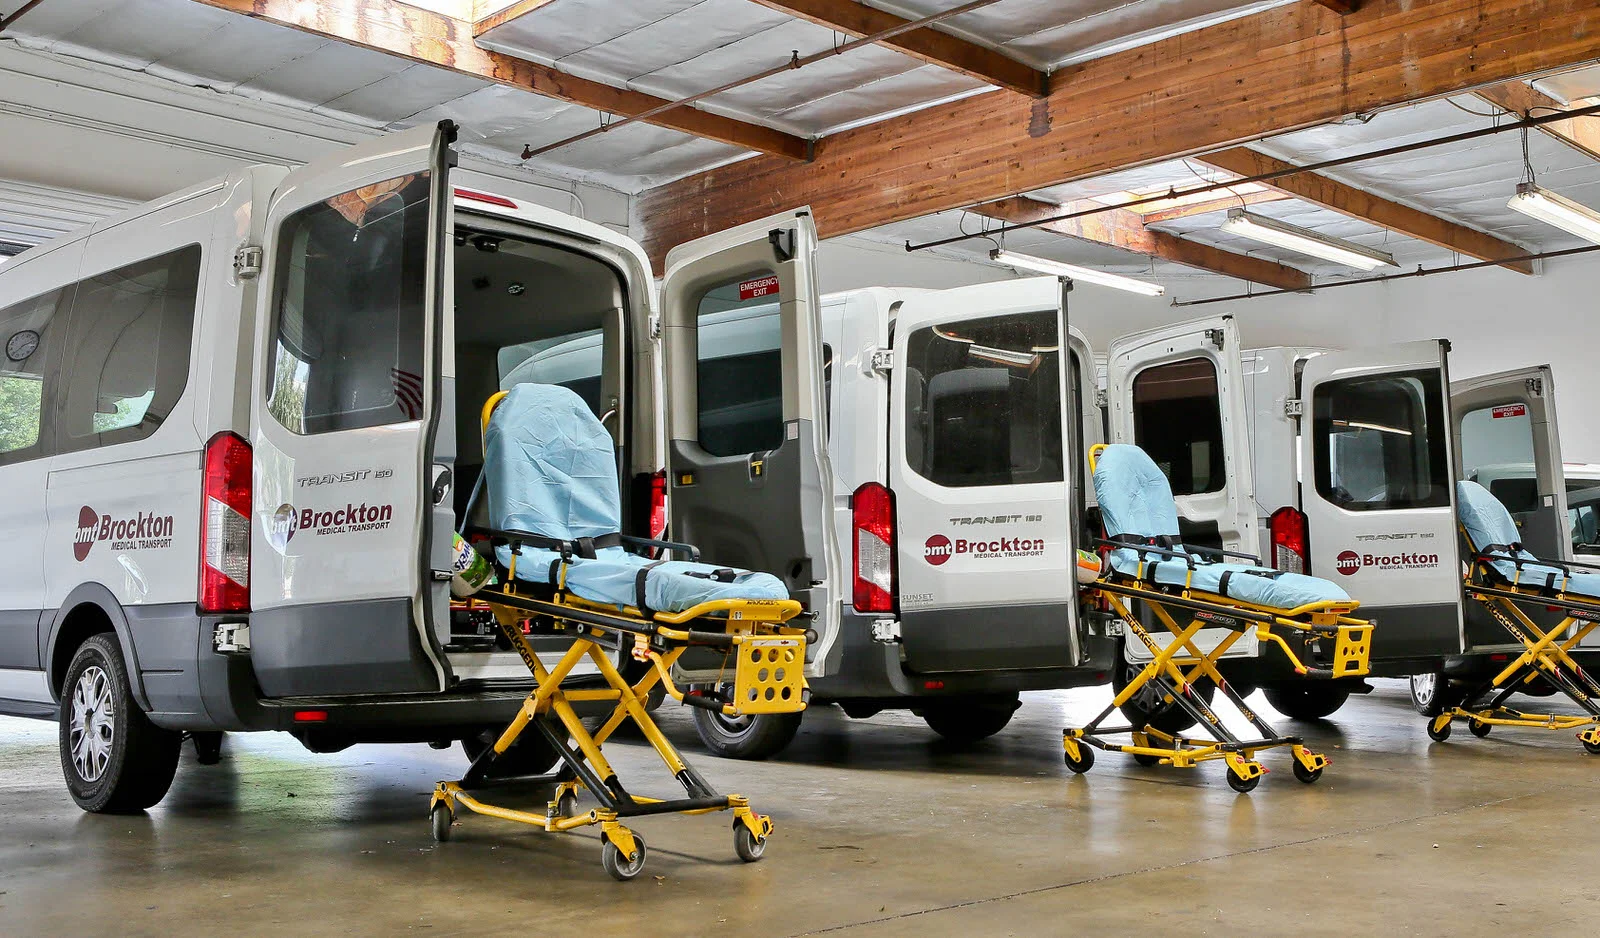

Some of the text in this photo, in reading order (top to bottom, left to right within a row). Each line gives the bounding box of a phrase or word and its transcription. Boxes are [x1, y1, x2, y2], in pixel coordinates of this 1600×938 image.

[740, 277, 778, 291] EMERGENCY
[753, 287, 767, 297] EXIT
[1493, 405, 1523, 413] EMERGENCY
[297, 468, 393, 487] TRANSIT 150
[299, 502, 393, 530] Brockton
[949, 514, 1022, 526] TRANSIT
[98, 510, 174, 541] Brockton
[316, 521, 391, 536] MEDICAL TRANSPORT
[1355, 532, 1417, 541] TRANSIT
[110, 538, 172, 551] MEDICAL TRANSPORT
[955, 537, 1044, 554] Brockton
[974, 550, 1044, 559] MEDICAL TRANSPORT
[1362, 552, 1438, 566] Brockton
[902, 592, 934, 601] SUNSET
[505, 626, 536, 669] RUGGED
